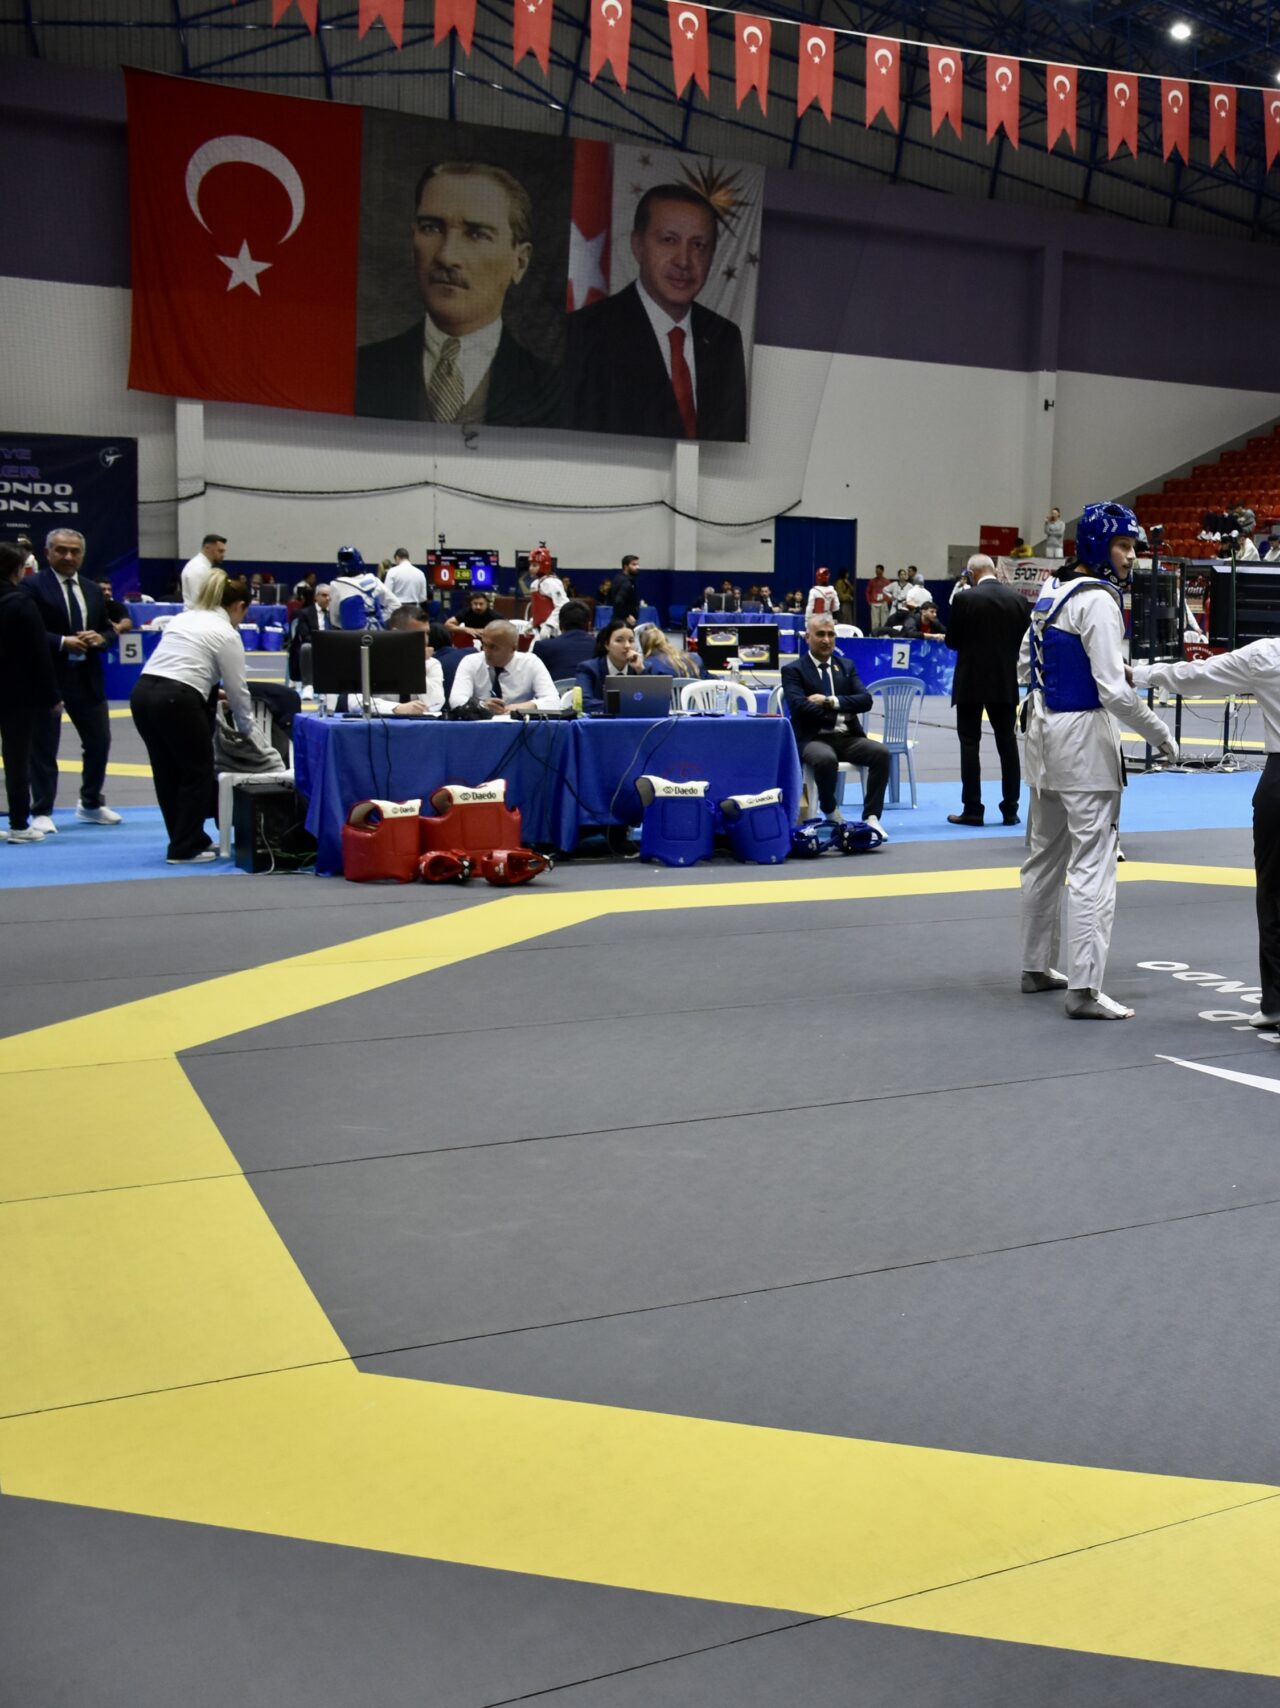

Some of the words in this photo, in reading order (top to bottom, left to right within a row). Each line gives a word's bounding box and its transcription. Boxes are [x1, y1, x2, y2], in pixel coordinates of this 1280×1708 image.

[441, 569, 449, 581] 0
[477, 569, 485, 581] 0
[125, 643, 137, 659] 5
[896, 651, 906, 665] 2
[472, 791, 497, 800] Daedo
[674, 786, 698, 795] Daedo
